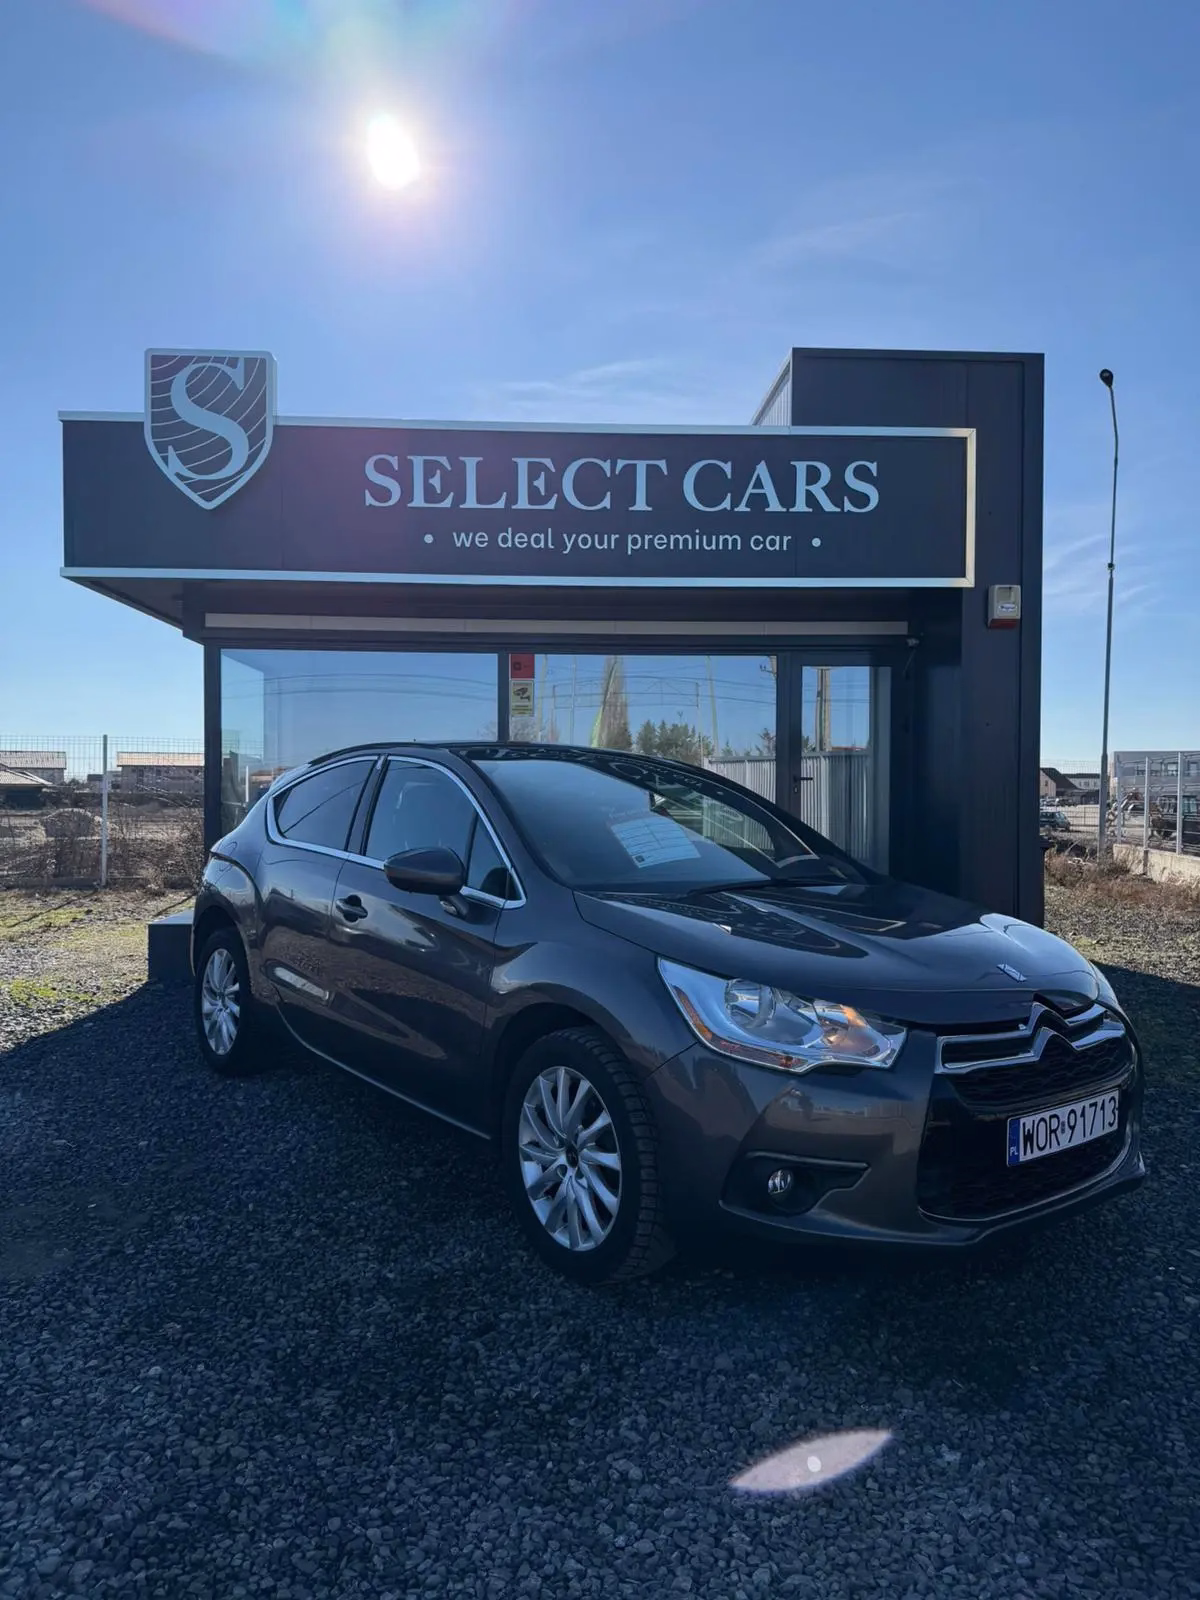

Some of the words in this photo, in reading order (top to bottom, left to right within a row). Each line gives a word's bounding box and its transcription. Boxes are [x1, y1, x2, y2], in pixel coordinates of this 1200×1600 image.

[167, 356, 250, 480] S
[364, 453, 668, 512] SELECT
[682, 459, 880, 514] CARS
[452, 531, 489, 549] we
[497, 526, 555, 549] deal
[562, 532, 620, 556] your
[627, 529, 742, 556] premium
[750, 534, 792, 551] car
[1009, 1146, 1019, 1157] PL
[1022, 1113, 1061, 1157] WOR
[1067, 1095, 1118, 1144] 91713
